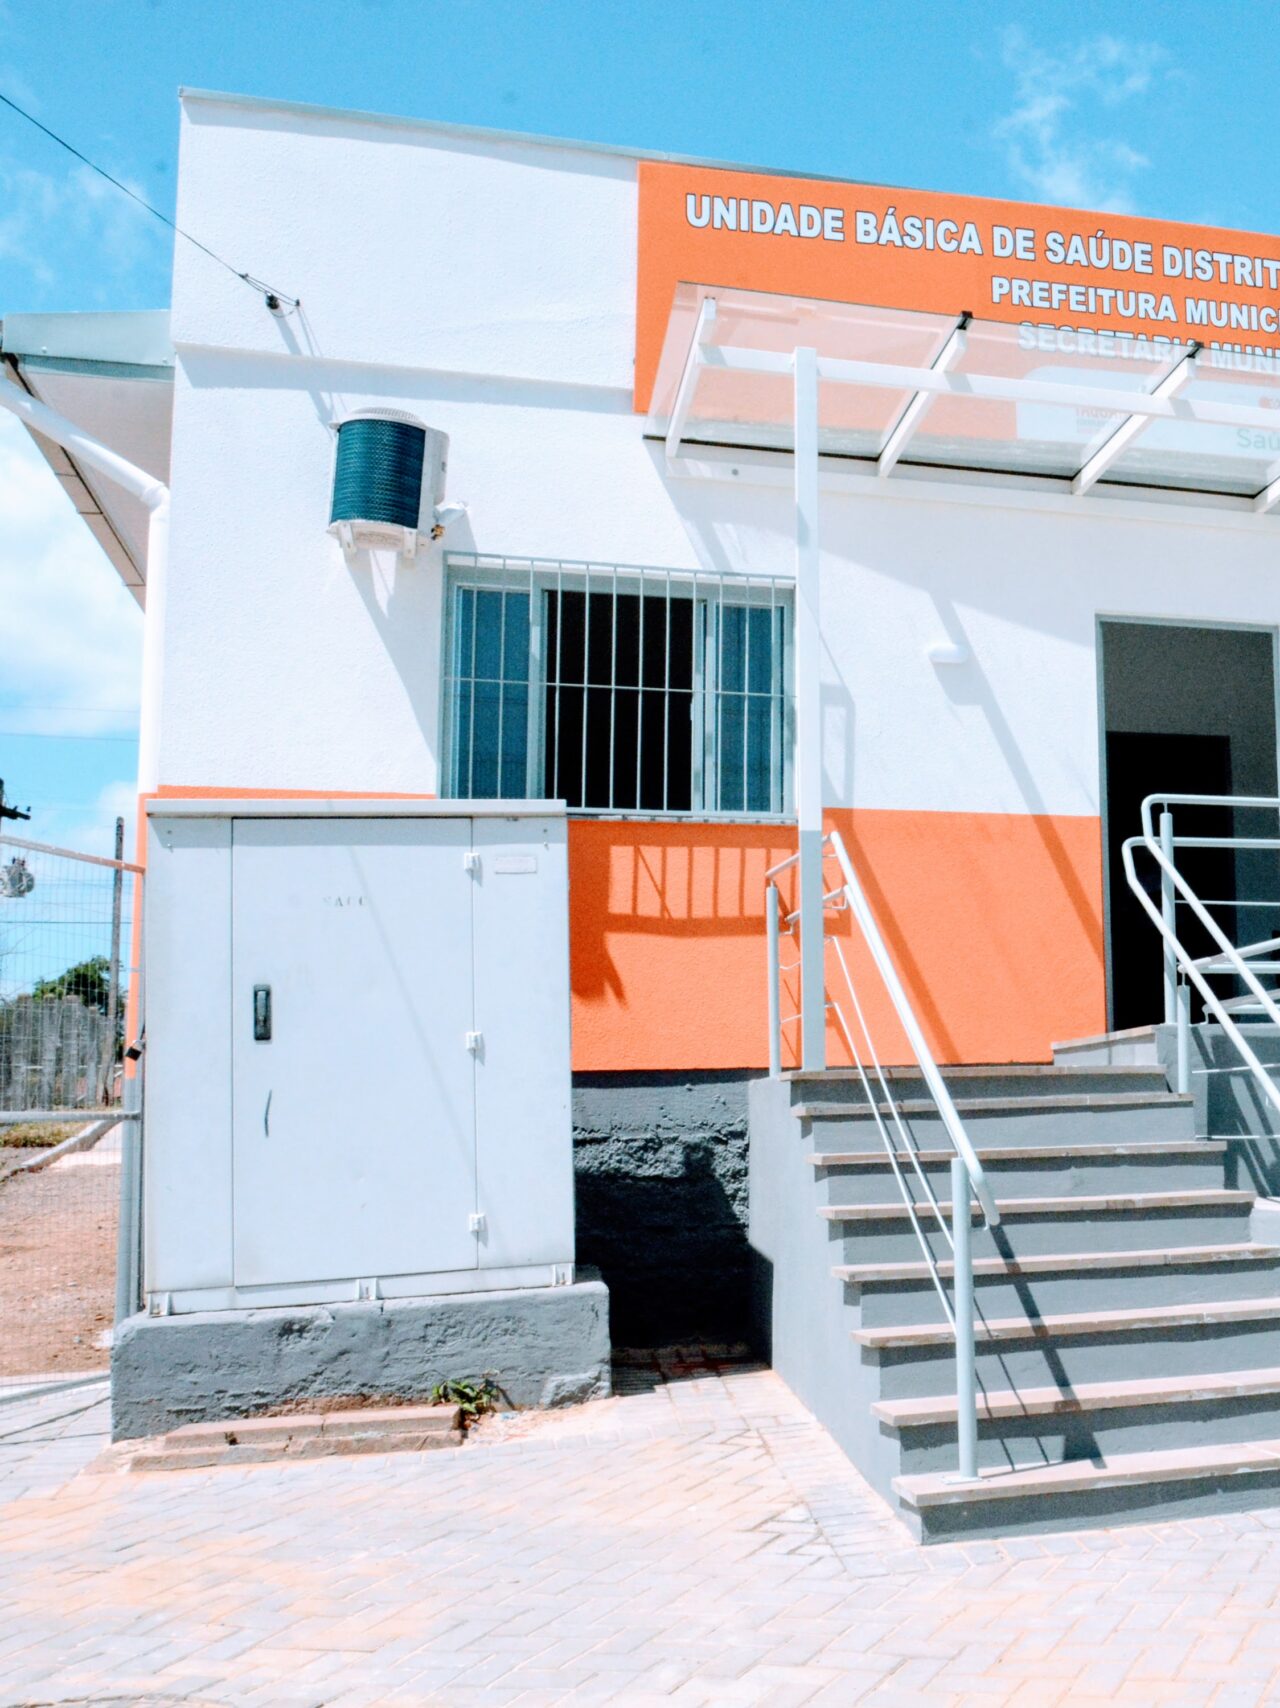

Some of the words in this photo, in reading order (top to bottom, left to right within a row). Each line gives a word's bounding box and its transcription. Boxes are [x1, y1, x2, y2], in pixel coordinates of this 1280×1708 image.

[686, 193, 845, 242] UNIDADE
[855, 207, 983, 256] BÁSICA
[991, 226, 1035, 261] DE
[1044, 230, 1152, 275] SAÚDE
[991, 275, 1178, 323] PREFEITURA
